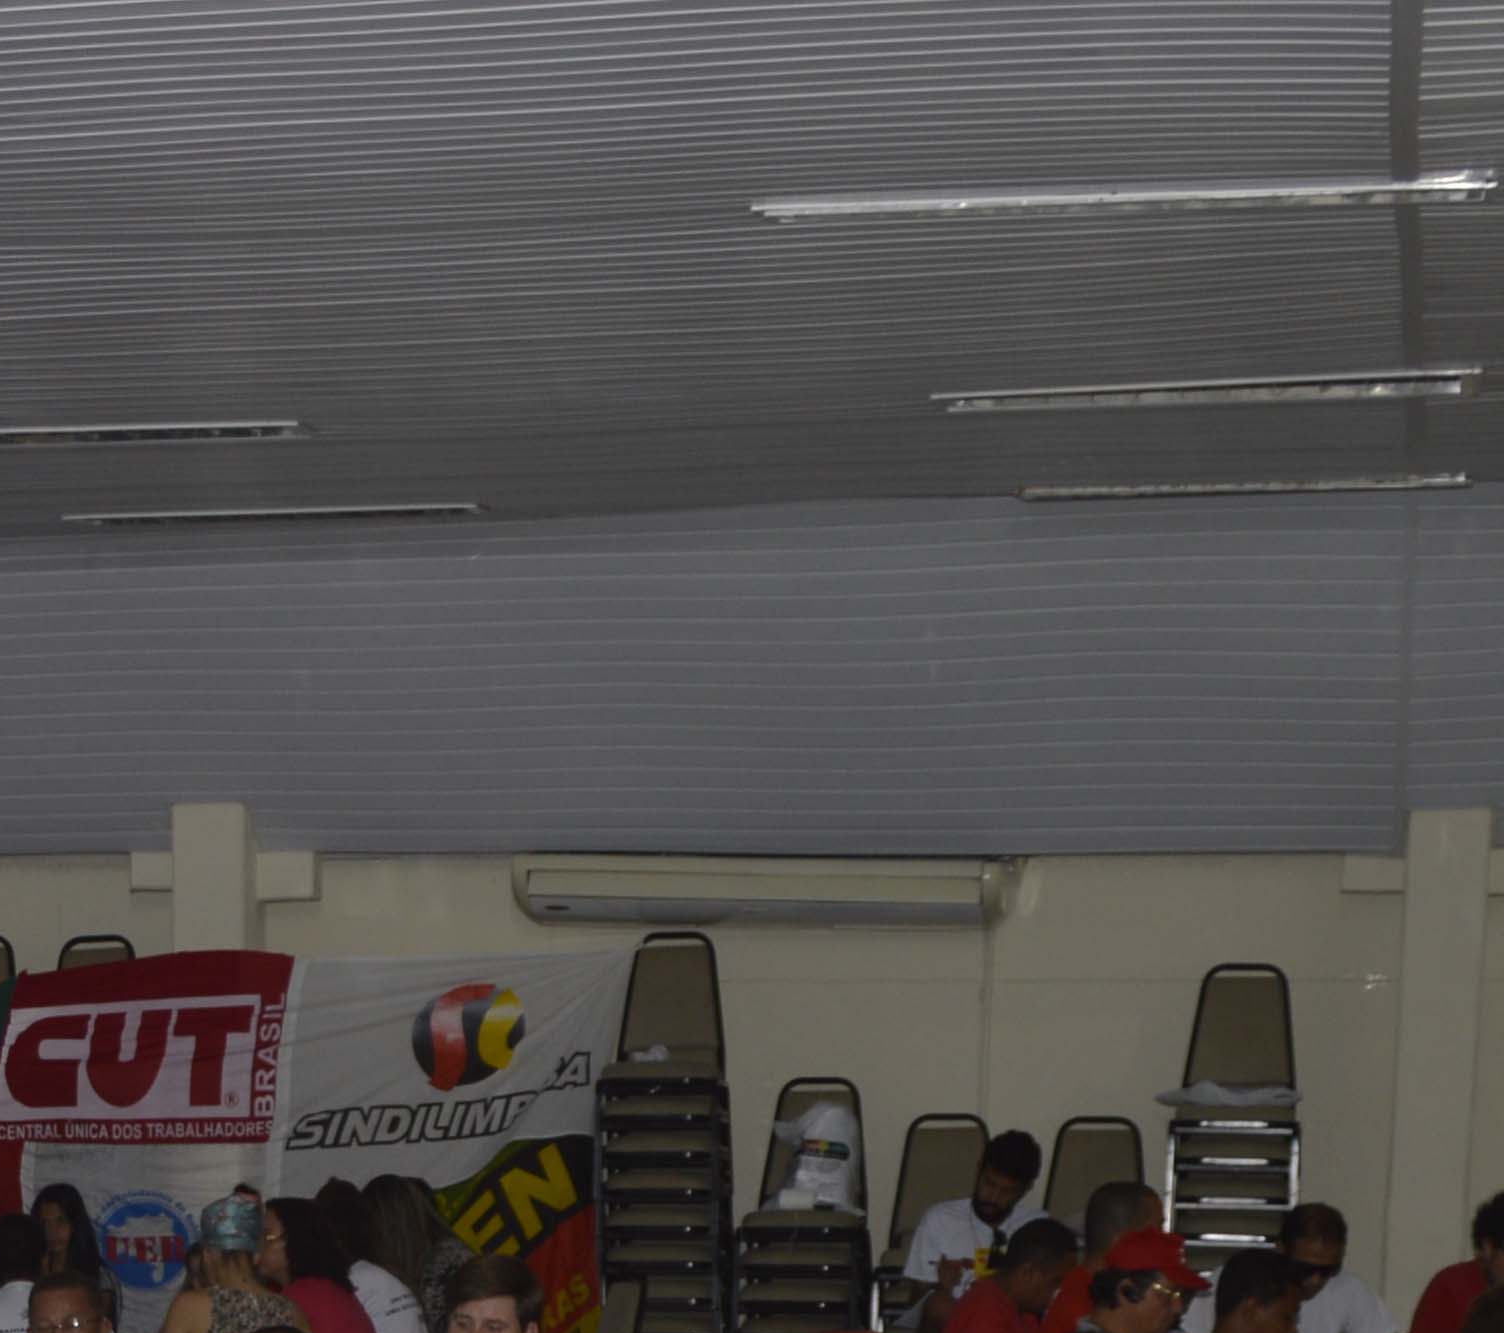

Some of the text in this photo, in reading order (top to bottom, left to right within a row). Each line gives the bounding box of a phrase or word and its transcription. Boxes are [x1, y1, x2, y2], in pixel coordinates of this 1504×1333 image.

[5, 1005, 256, 1108] CUT
[253, 992, 286, 1117] BRASIL
[65, 1119, 109, 1139] ÚNICA
[112, 1122, 142, 1139] DOS
[147, 1119, 274, 1138] TRABALHADORES
